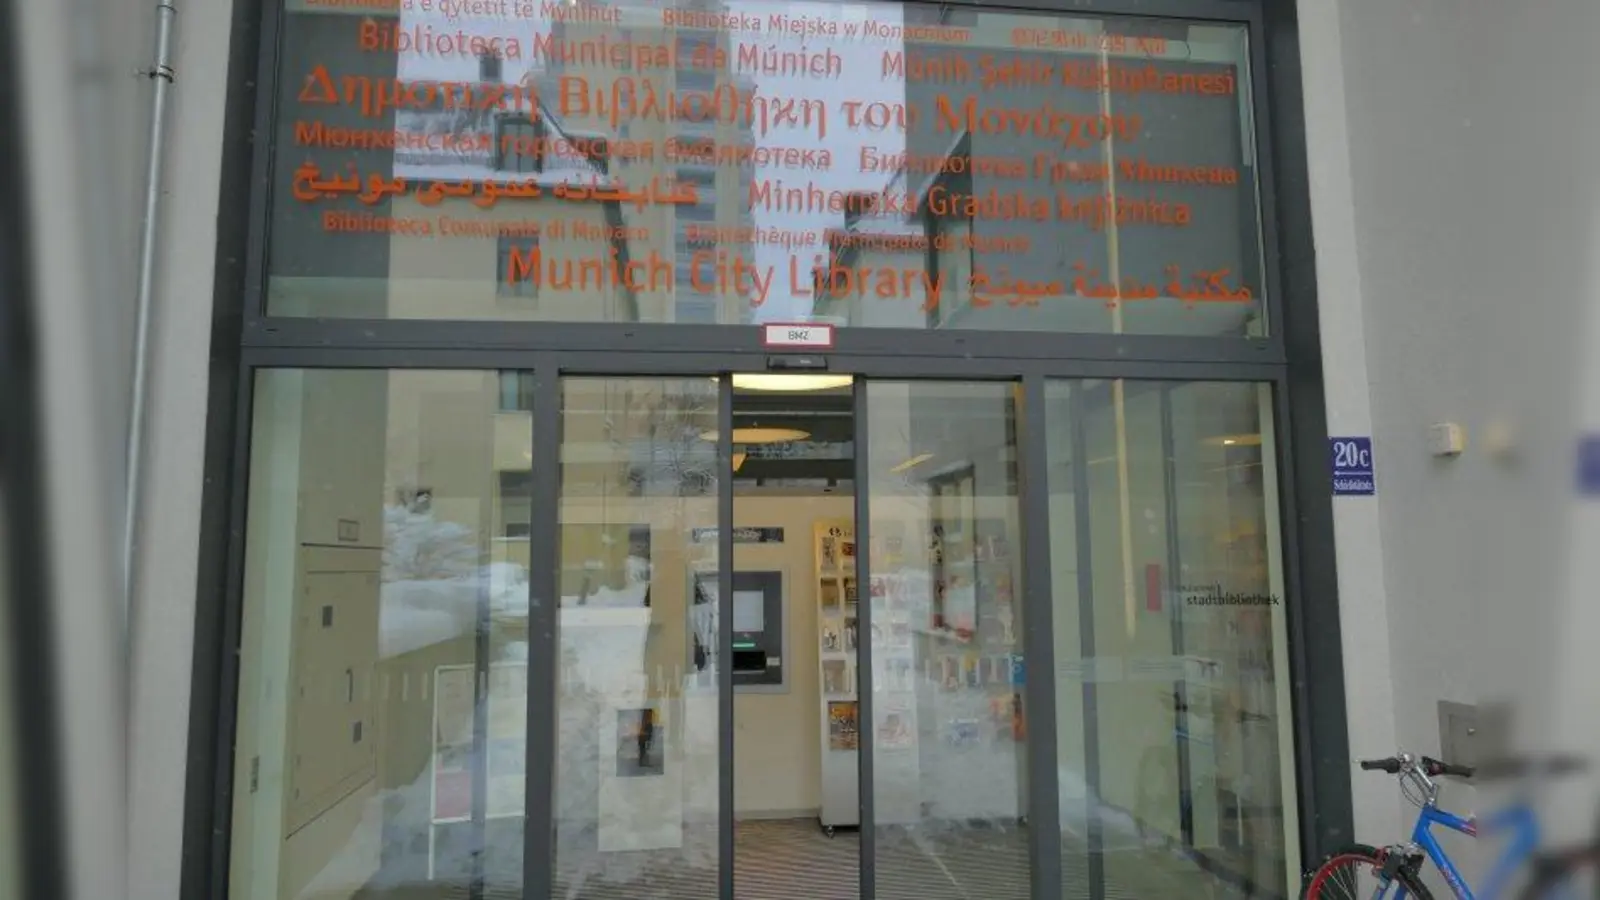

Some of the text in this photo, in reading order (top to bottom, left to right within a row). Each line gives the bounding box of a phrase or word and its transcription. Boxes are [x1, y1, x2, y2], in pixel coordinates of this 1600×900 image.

[768, 14, 838, 39] Miejska
[843, 23, 857, 37] w
[358, 20, 520, 59] Biblioteca
[533, 31, 681, 72] Municipal
[737, 43, 842, 77] Múnich
[840, 99, 919, 133] του
[506, 244, 944, 313] Munich City Library
[1333, 441, 1370, 467] 20c
[1186, 591, 1280, 606] stadtbibliothek
